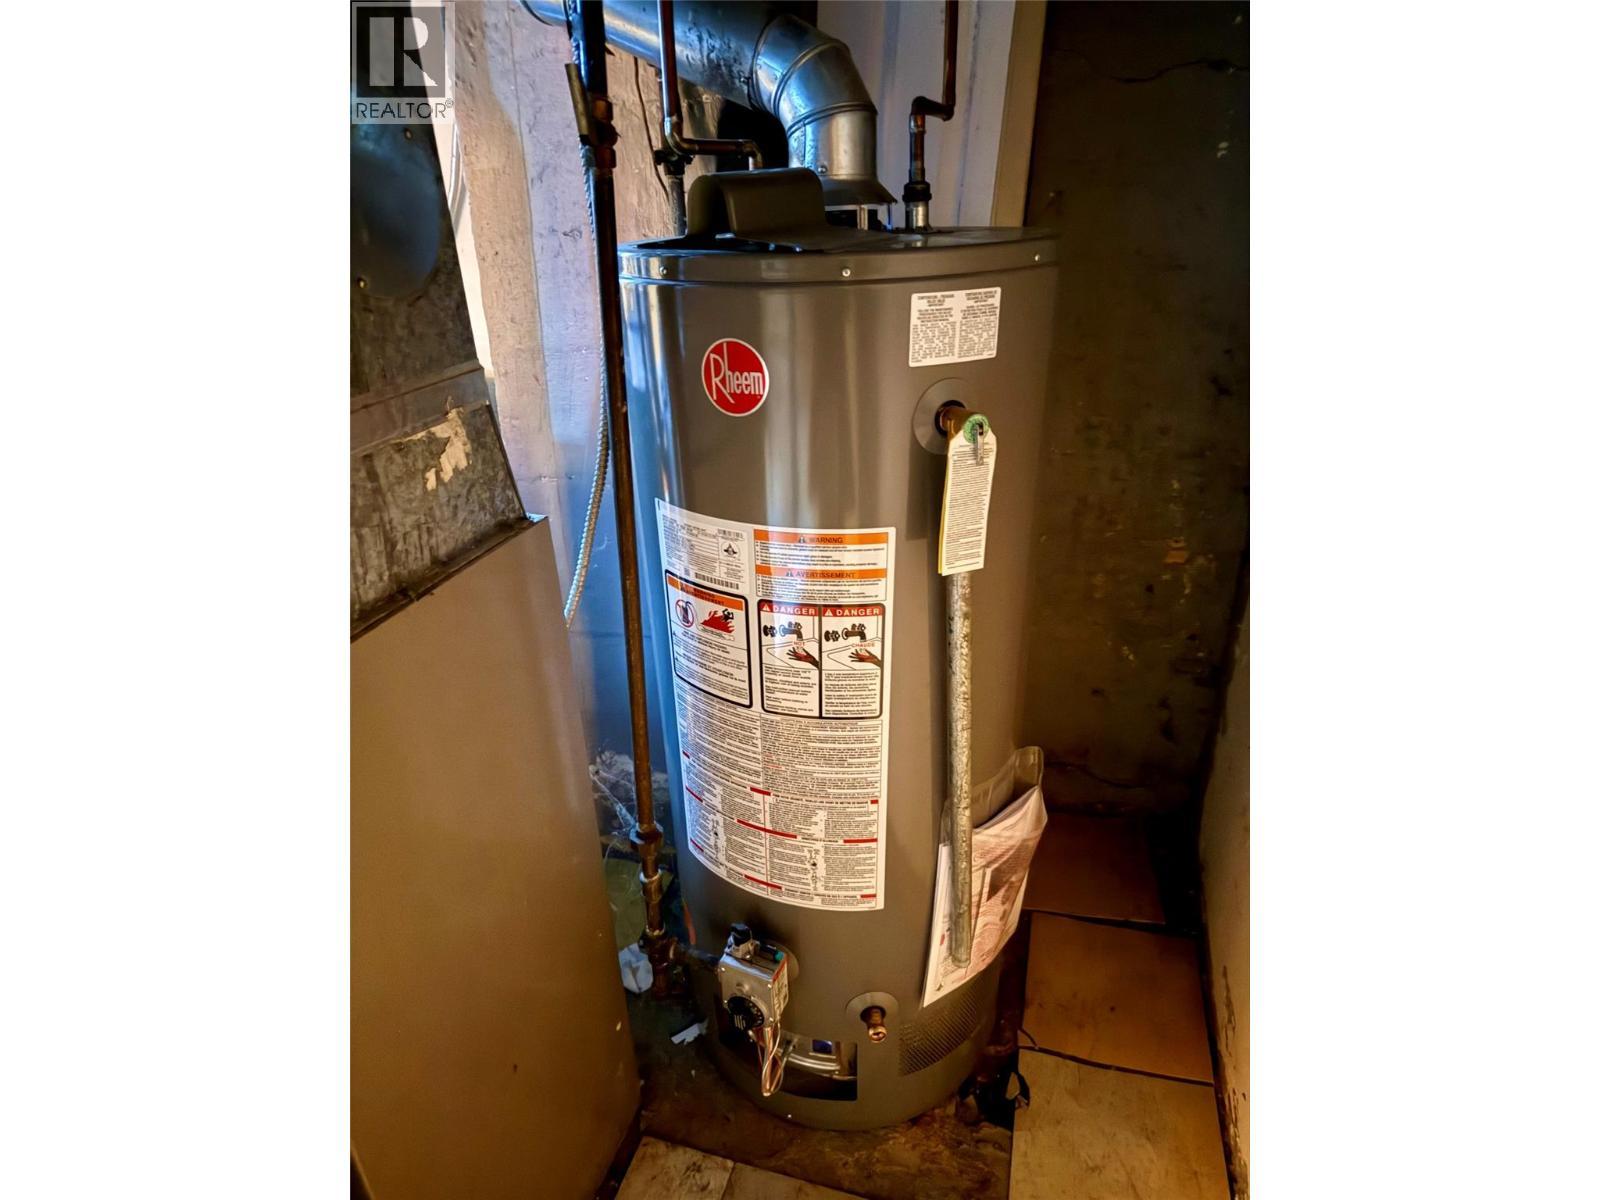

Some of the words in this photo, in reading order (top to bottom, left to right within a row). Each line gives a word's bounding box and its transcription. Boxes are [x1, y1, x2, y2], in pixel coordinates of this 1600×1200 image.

[709, 342, 764, 404] Rheem
[772, 605, 816, 616] DANGER
[836, 608, 880, 617] DANGER
